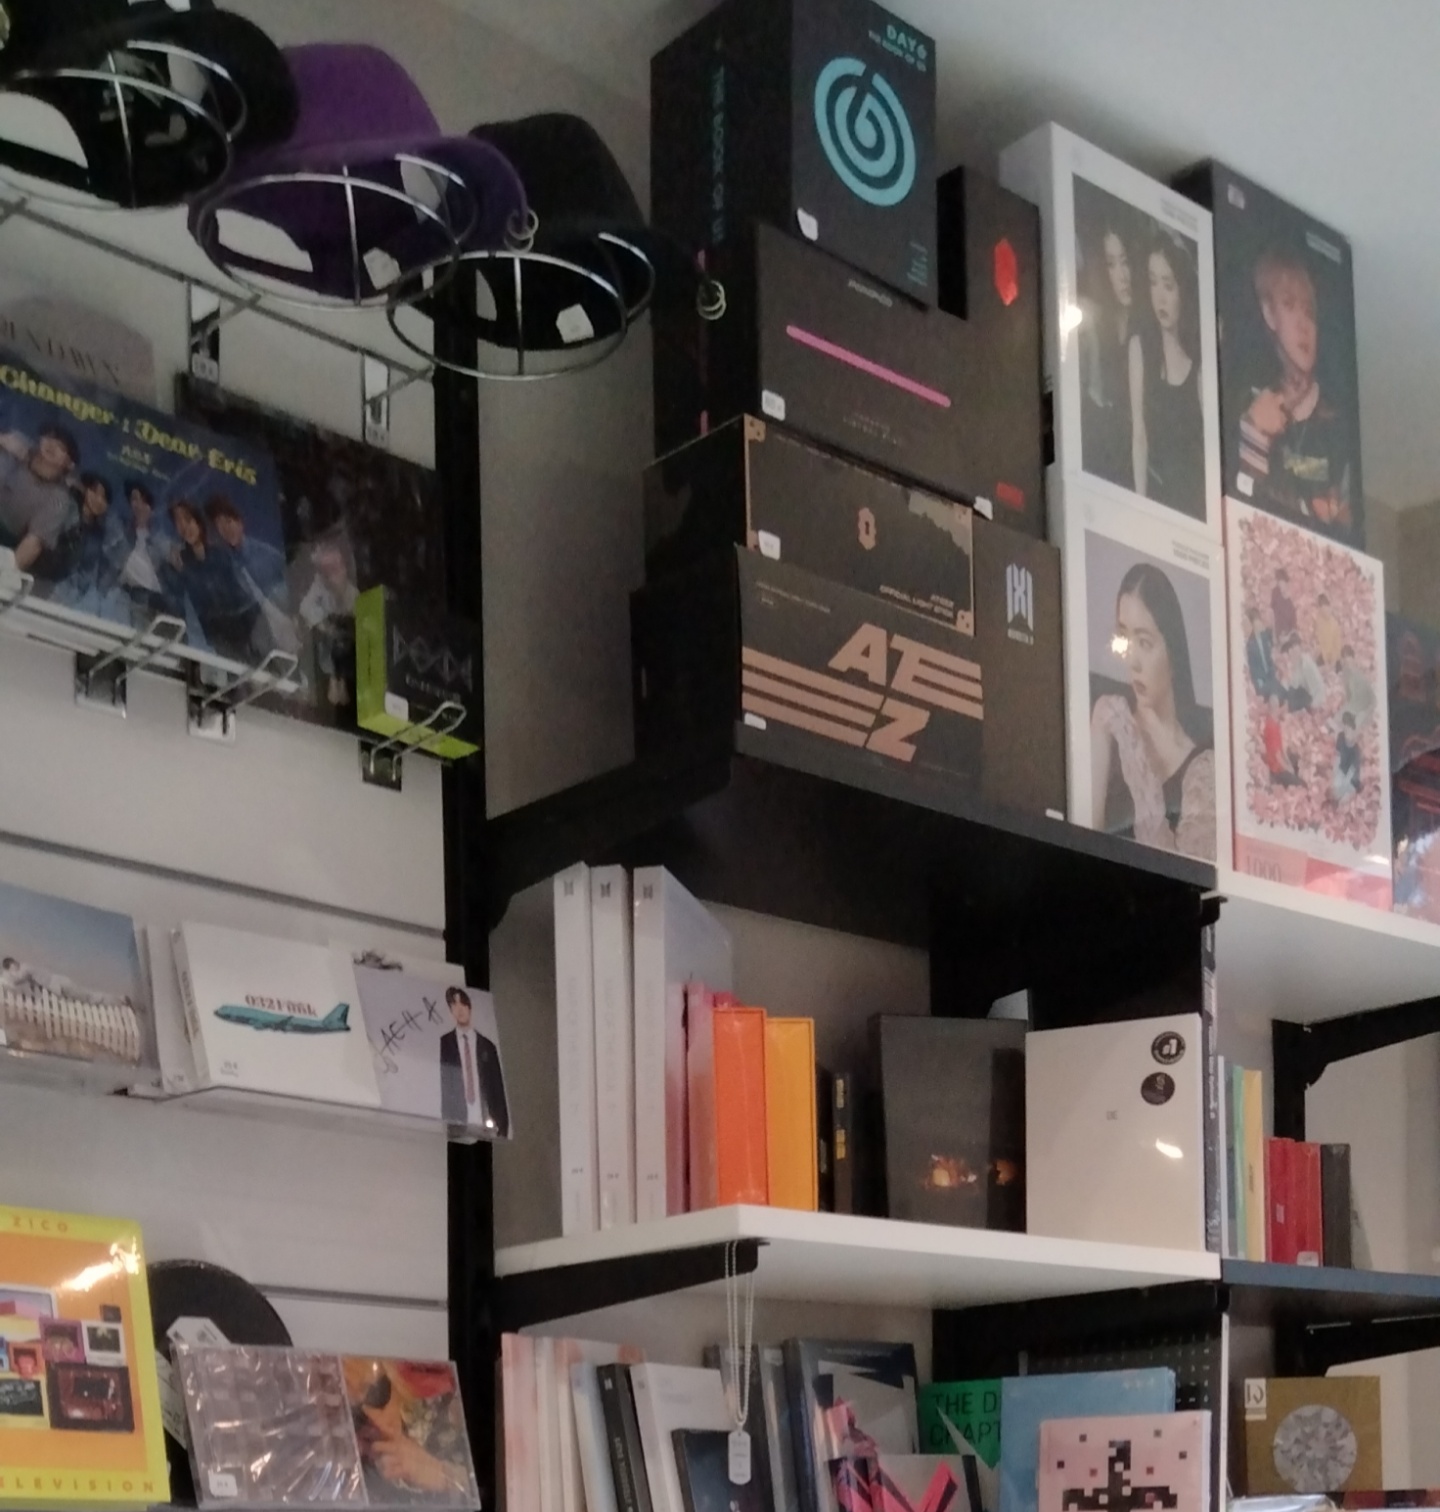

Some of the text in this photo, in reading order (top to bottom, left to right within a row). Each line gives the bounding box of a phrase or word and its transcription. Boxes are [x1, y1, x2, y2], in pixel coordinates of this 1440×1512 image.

[887, 24, 927, 60] DAY6
[134, 419, 201, 460] Dear
[208, 448, 257, 486] Eris
[13, 1215, 69, 1234] ZICO
[930, 1391, 974, 1415] THE
